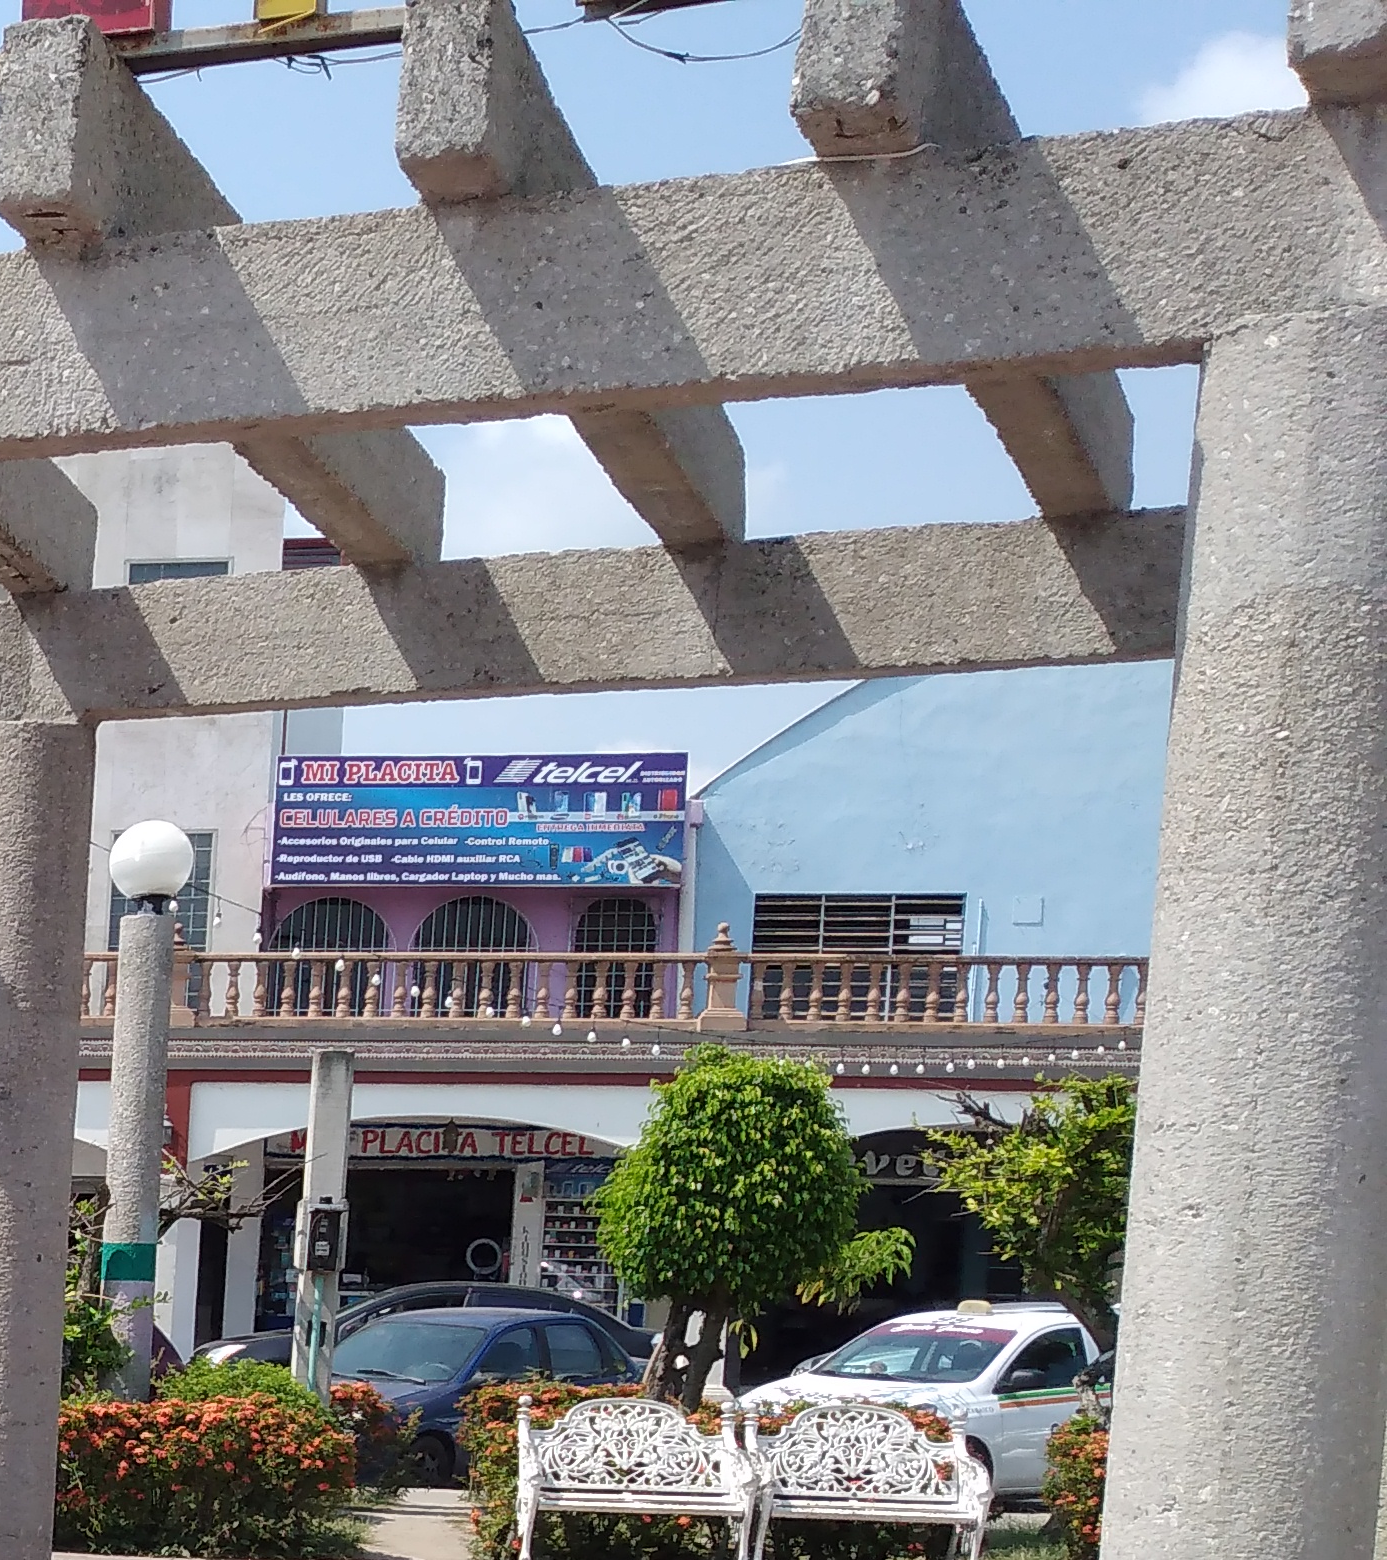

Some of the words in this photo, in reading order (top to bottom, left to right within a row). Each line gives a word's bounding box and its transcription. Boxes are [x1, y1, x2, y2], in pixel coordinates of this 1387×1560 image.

[302, 761, 340, 784] MI
[344, 761, 460, 784] PLACITA
[533, 761, 643, 783] telcel
[283, 793, 304, 802] LES
[306, 793, 352, 802] OFRECE:
[280, 808, 397, 828] CELULARES
[400, 809, 415, 828] A
[420, 804, 509, 828] CRÉDITO
[536, 823, 584, 833] ENTREGA
[586, 822, 645, 832] INMEDIATA
[277, 836, 338, 846] -Accesorios
[340, 836, 392, 848] Originales
[395, 838, 418, 848] para
[420, 836, 458, 846] Celular
[464, 837, 505, 846] -Control
[508, 837, 550, 846] Remoto
[276, 854, 343, 865] -Reproductor
[345, 854, 359, 863] de
[361, 854, 382, 863] USB
[390, 854, 424, 863] -Cable
[426, 854, 454, 863] HDMI
[456, 855, 496, 864] auxiliar
[499, 855, 521, 863] RCA
[330, 872, 364, 881] Manos
[367, 872, 400, 882] libres,
[401, 872, 449, 883] Cargador
[452, 873, 488, 883] Laptop
[490, 874, 497, 883] y
[498, 873, 534, 881] Mucho
[290, 1129, 307, 1152] M
[361, 1129, 478, 1154] PLACIA
[487, 1131, 595, 1156] TELCEL
